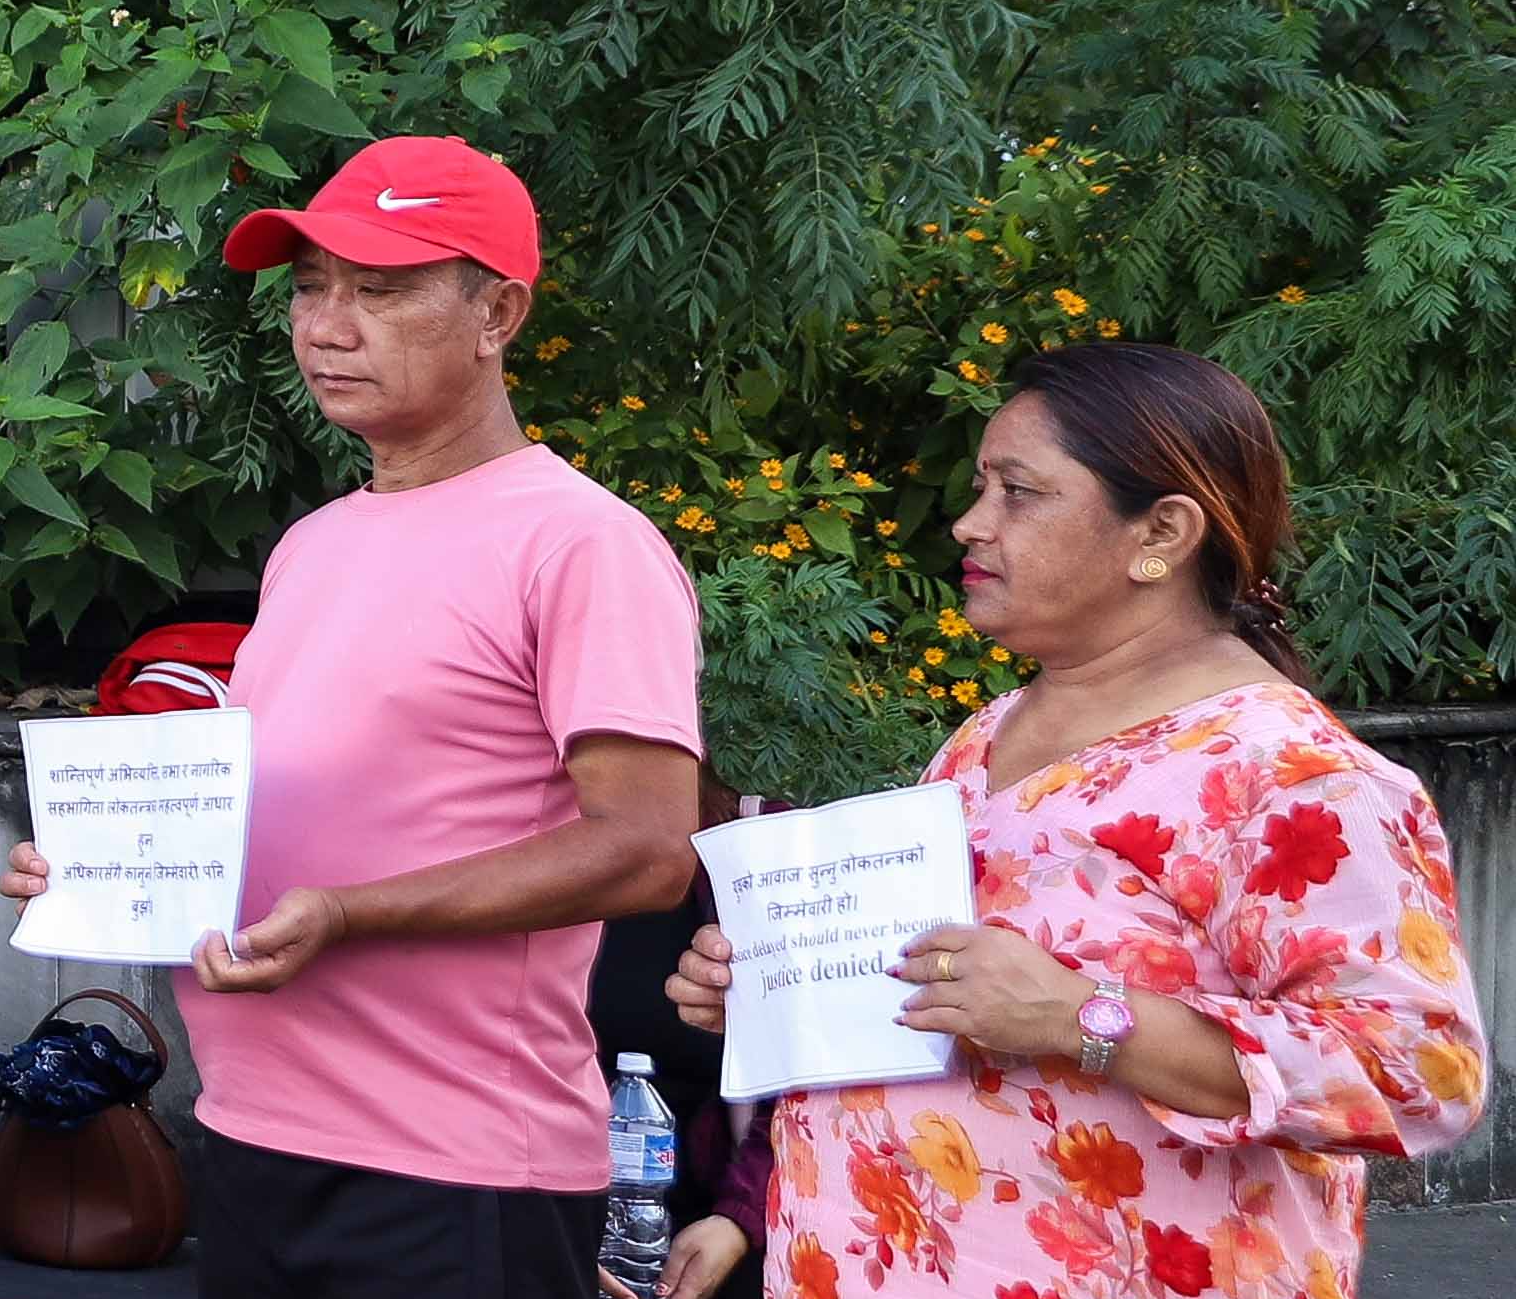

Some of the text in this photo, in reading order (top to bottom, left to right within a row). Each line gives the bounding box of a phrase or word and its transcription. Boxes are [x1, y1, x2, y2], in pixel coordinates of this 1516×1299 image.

[757, 866, 803, 889] आवाज
[840, 843, 926, 875] लोकतन्त्रको
[766, 892, 833, 923] जिम्मेवारी
[790, 924, 839, 950] should
[844, 922, 889, 942] never
[759, 965, 803, 999] justice
